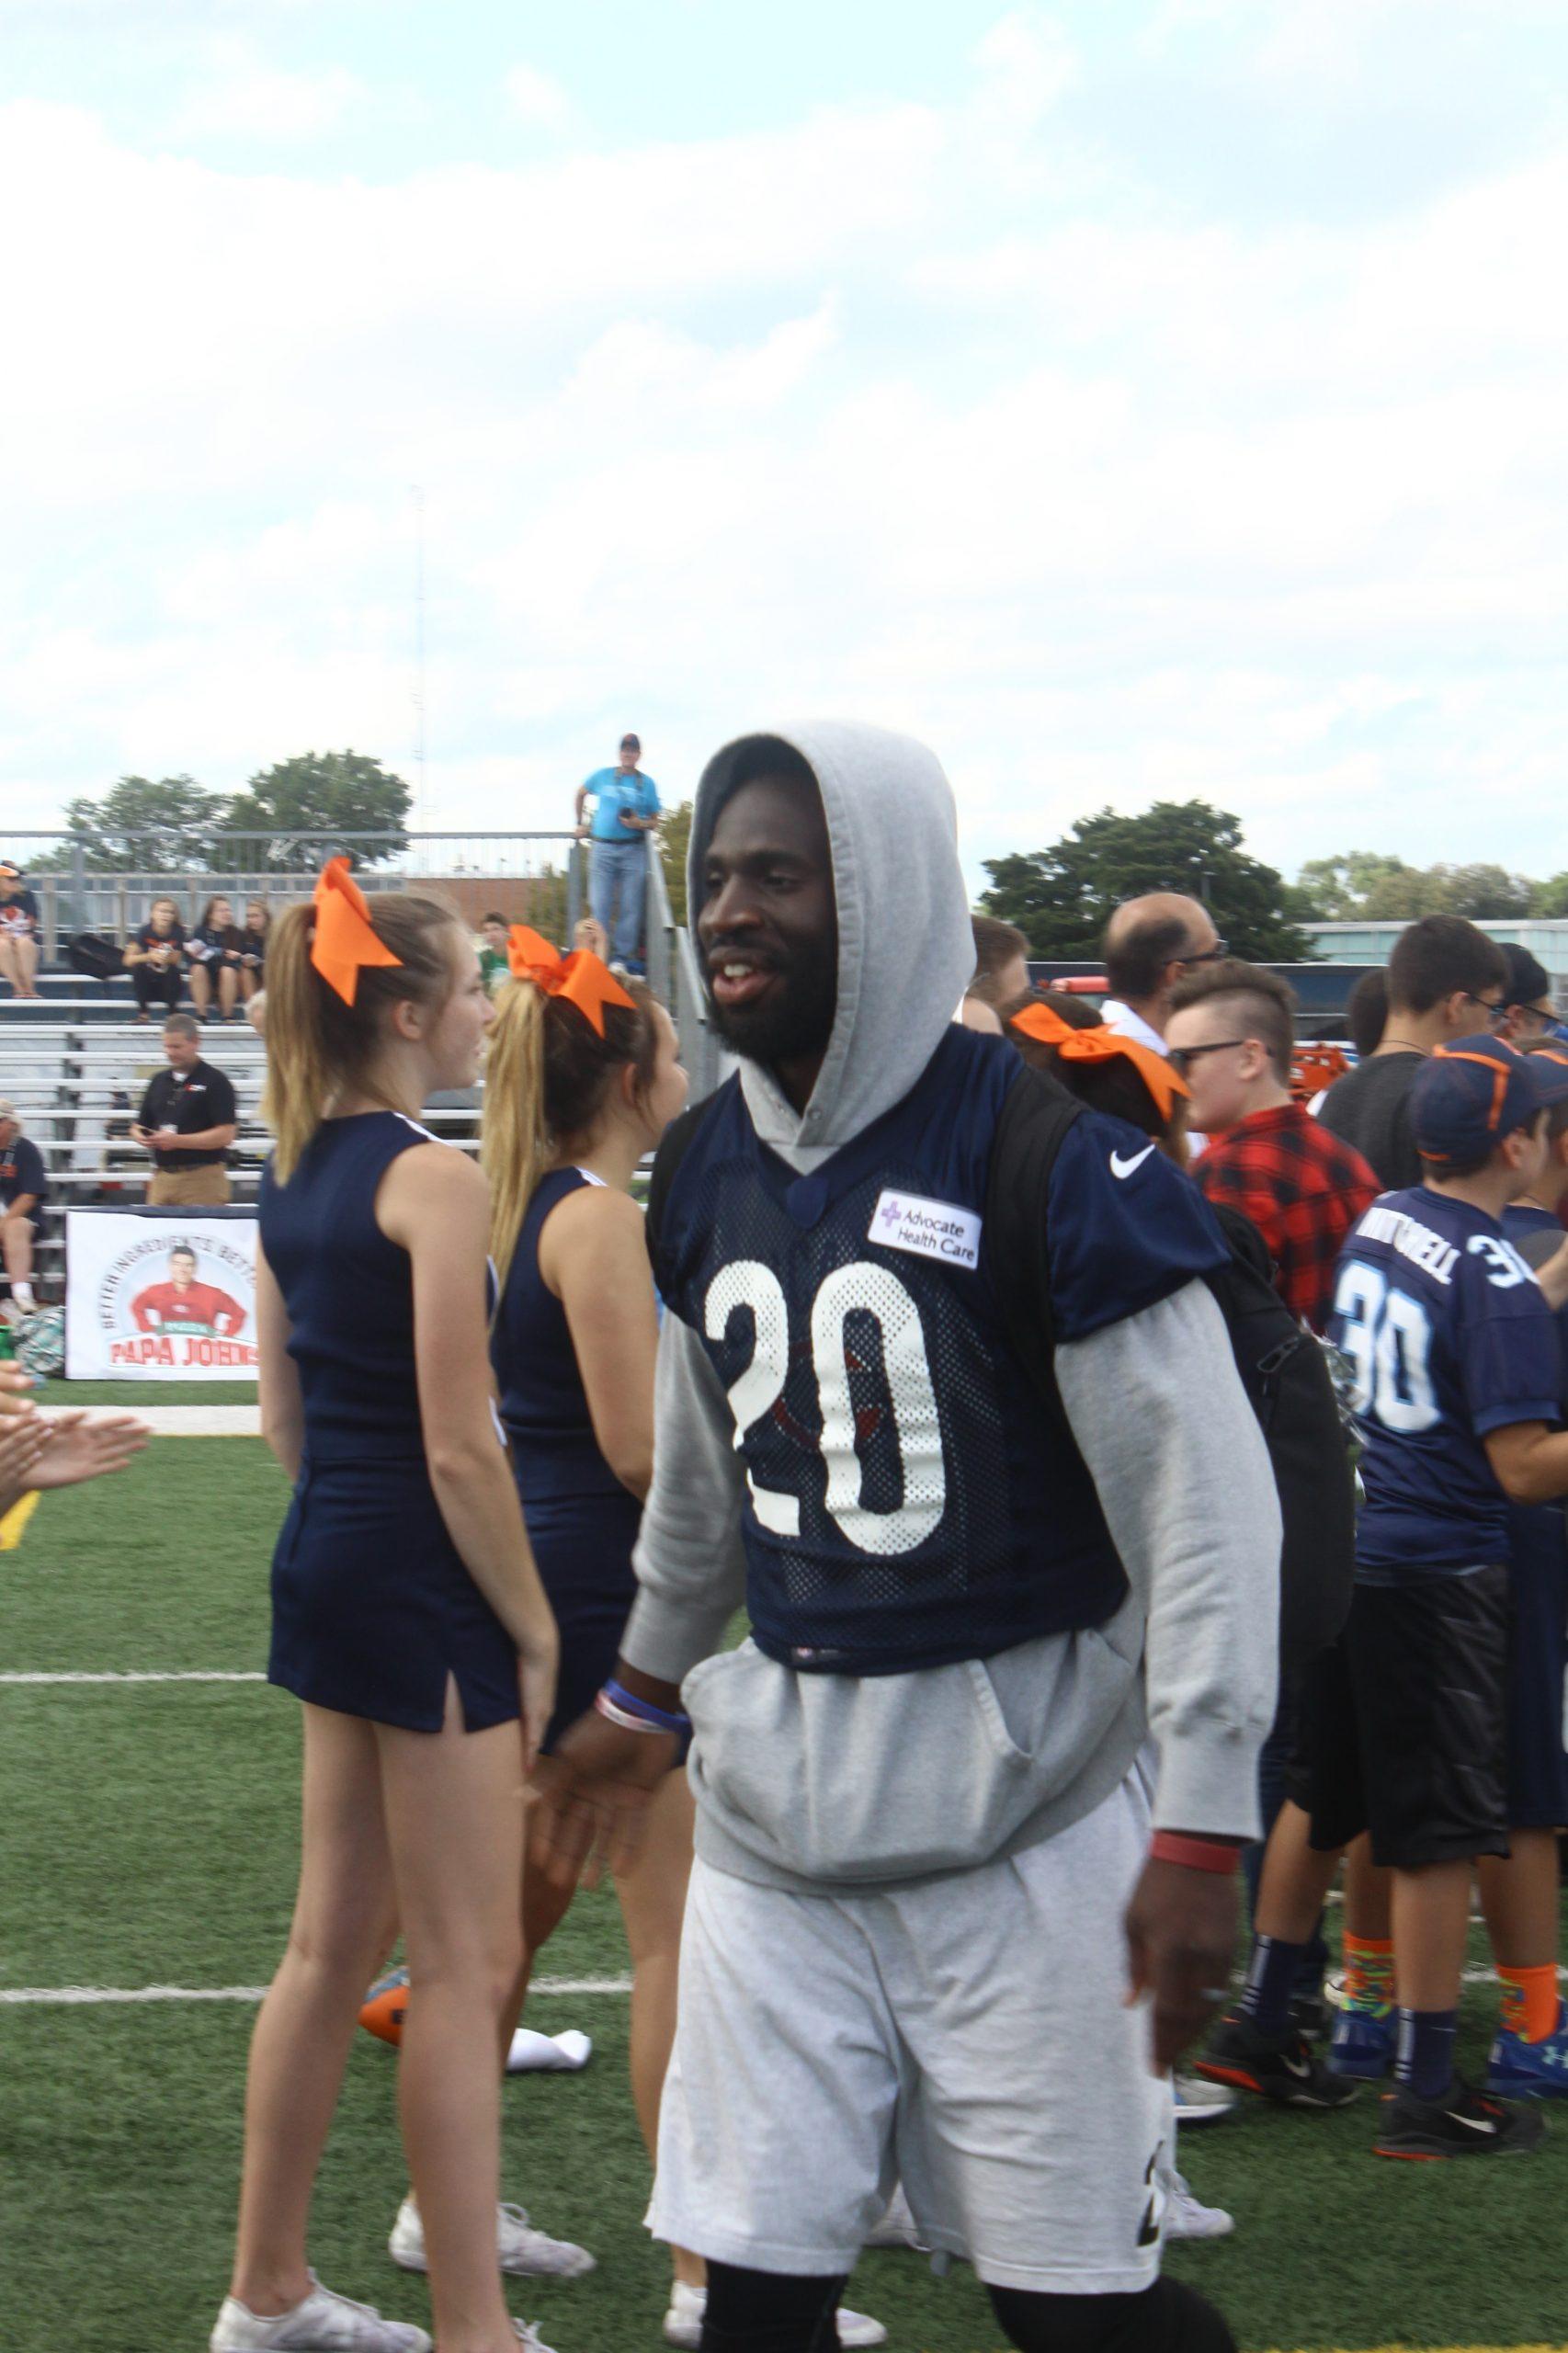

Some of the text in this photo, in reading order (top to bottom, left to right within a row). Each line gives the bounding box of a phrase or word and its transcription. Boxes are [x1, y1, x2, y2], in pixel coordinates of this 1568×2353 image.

[903, 1208, 964, 1238] Advocate
[897, 1228, 975, 1261] Health Care
[110, 1337, 175, 1365] PAPA
[1335, 1258, 1441, 1434] 30
[705, 1260, 946, 1555] 20
